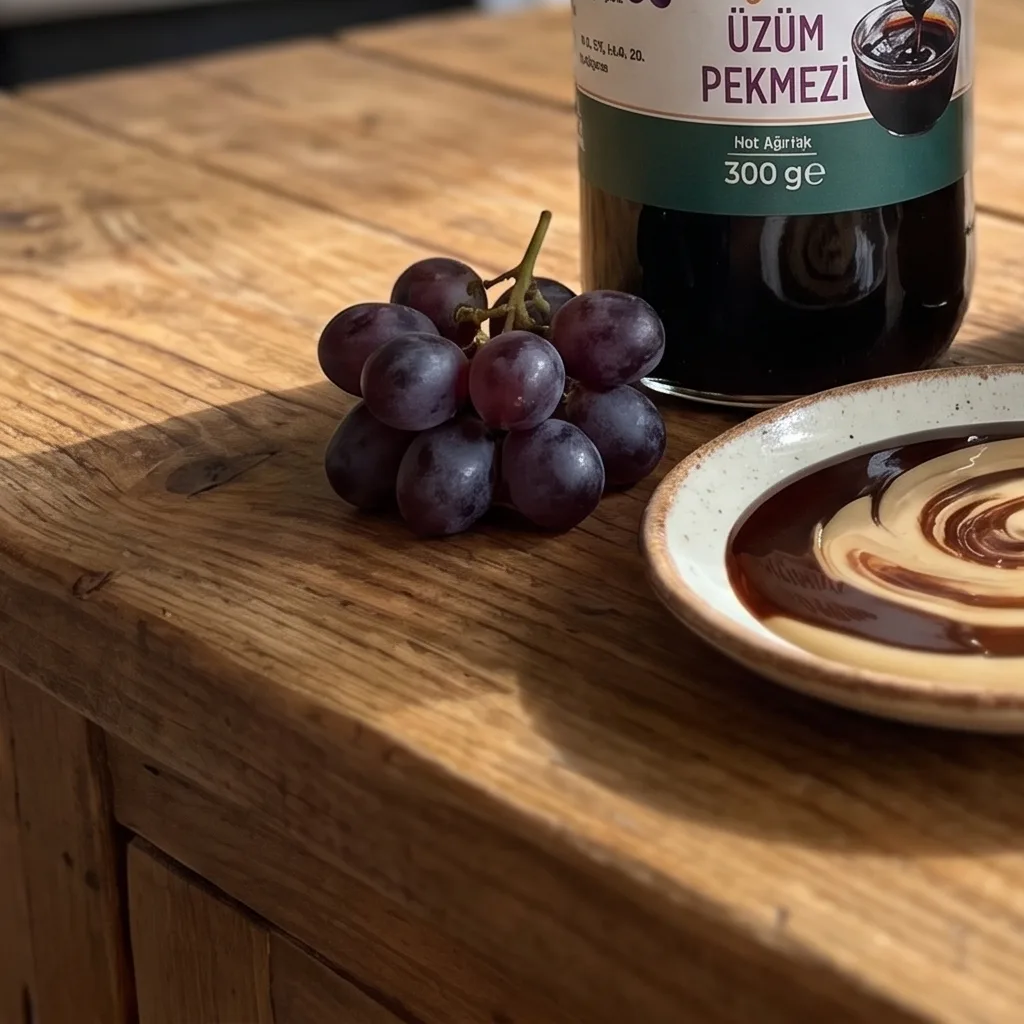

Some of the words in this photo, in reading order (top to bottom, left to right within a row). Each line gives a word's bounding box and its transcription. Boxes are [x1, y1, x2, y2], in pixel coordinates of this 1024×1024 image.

[728, 7, 824, 53] ÜZÜM
[702, 56, 848, 105] PEKMEZİ
[724, 160, 777, 186] 300
